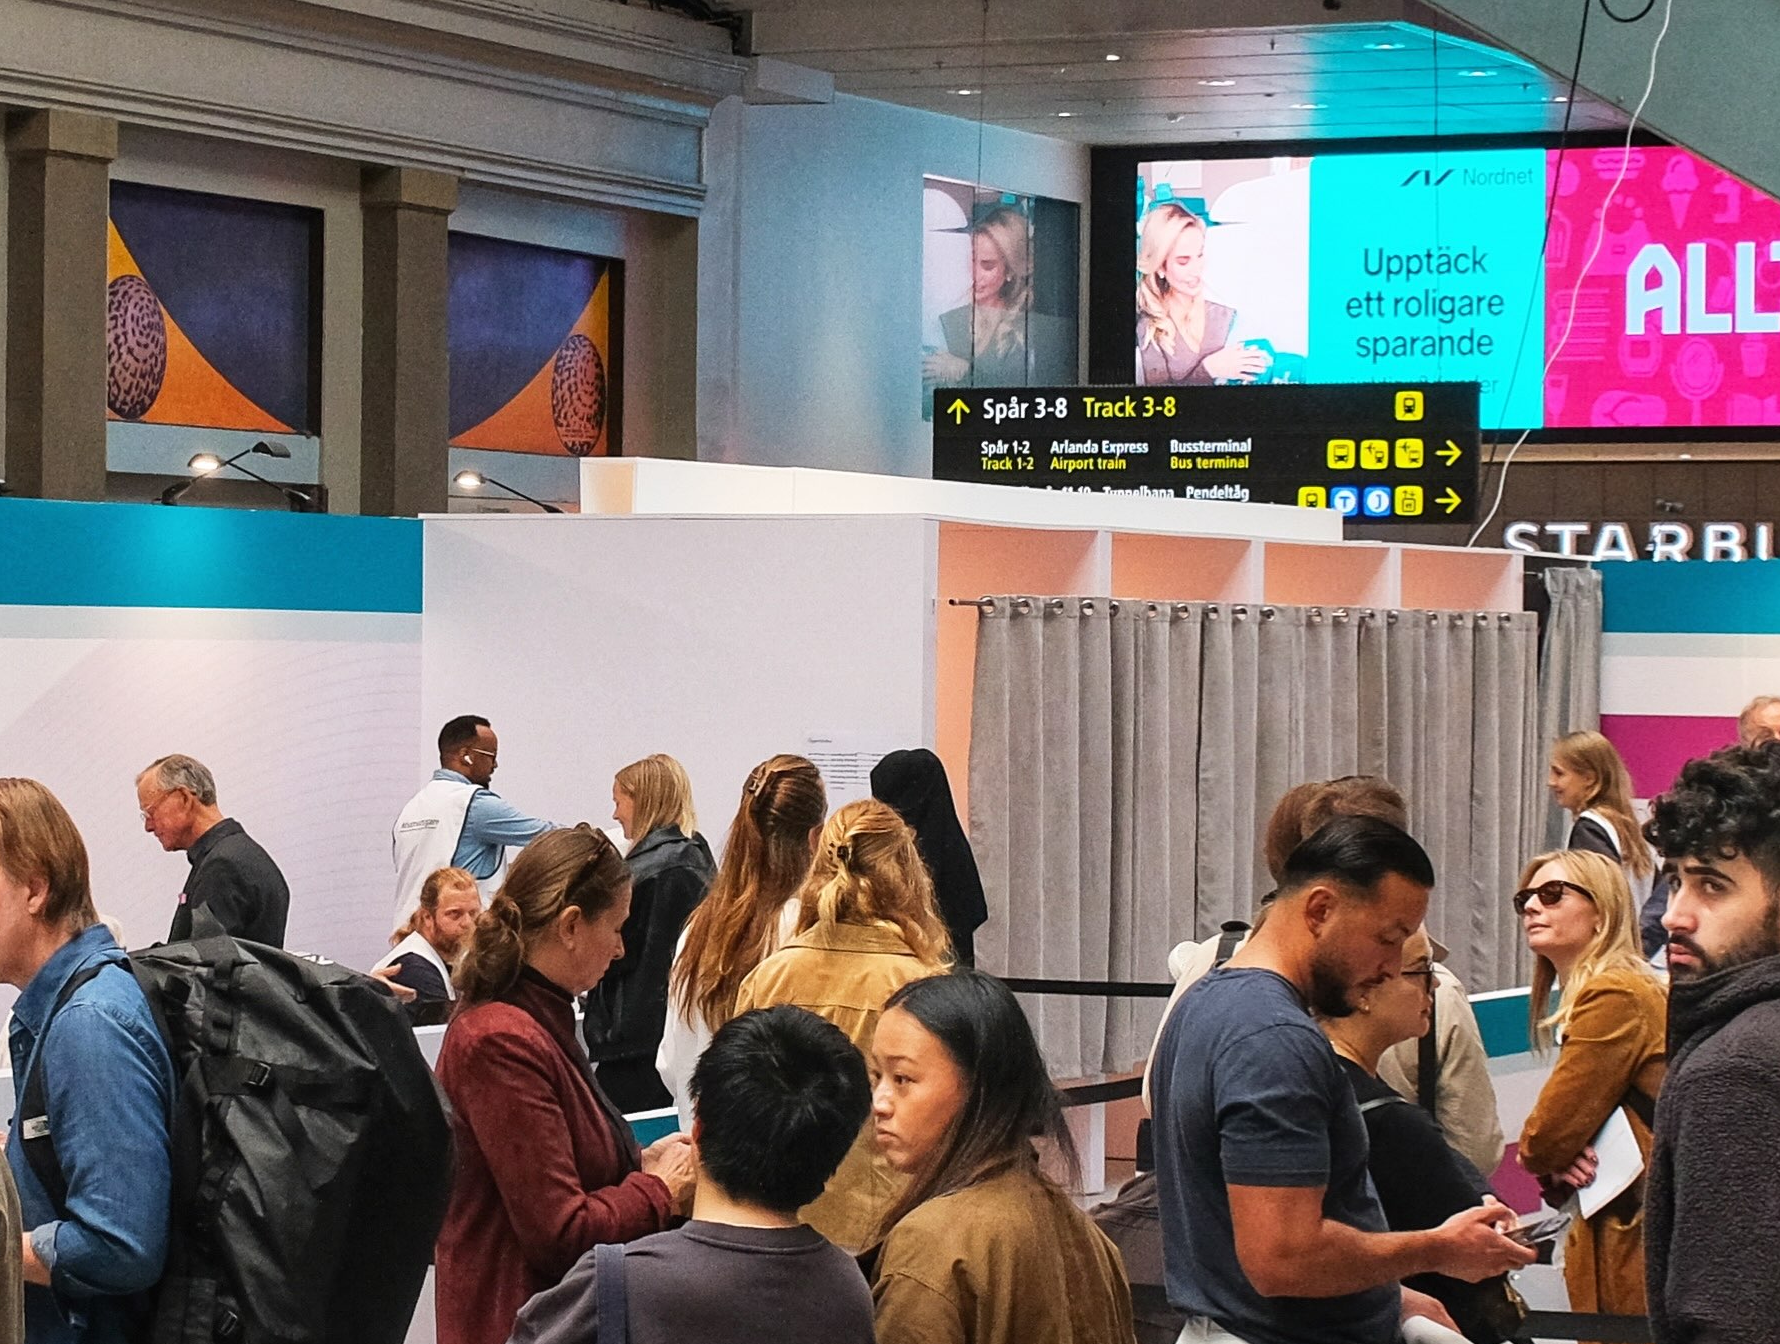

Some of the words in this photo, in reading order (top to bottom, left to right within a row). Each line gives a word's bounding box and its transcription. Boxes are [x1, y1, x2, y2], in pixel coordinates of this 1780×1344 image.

[1462, 168, 1534, 186] Nordnet
[1364, 245, 1489, 282] Upptäck
[1346, 290, 1385, 318] ett
[1394, 288, 1504, 324] roligare
[1356, 328, 1494, 364] sparande
[983, 397, 1029, 424] Spår
[1034, 397, 1068, 419] 3-8
[1083, 396, 1136, 418] Track
[1142, 396, 1177, 418] 3-8
[981, 439, 1008, 456] Spår
[1012, 441, 1030, 454] 1-2
[1050, 440, 1099, 455] Arlanda
[1102, 439, 1149, 458] Express
[1170, 438, 1252, 454] Bussterminal
[981, 457, 1013, 470] Track
[1017, 457, 1034, 470] 1-2
[1050, 456, 1094, 473] Airport
[1098, 457, 1126, 470] train
[1170, 456, 1193, 470] Bus
[1196, 455, 1249, 470] terminal
[1186, 486, 1250, 502] Pendeltåg
